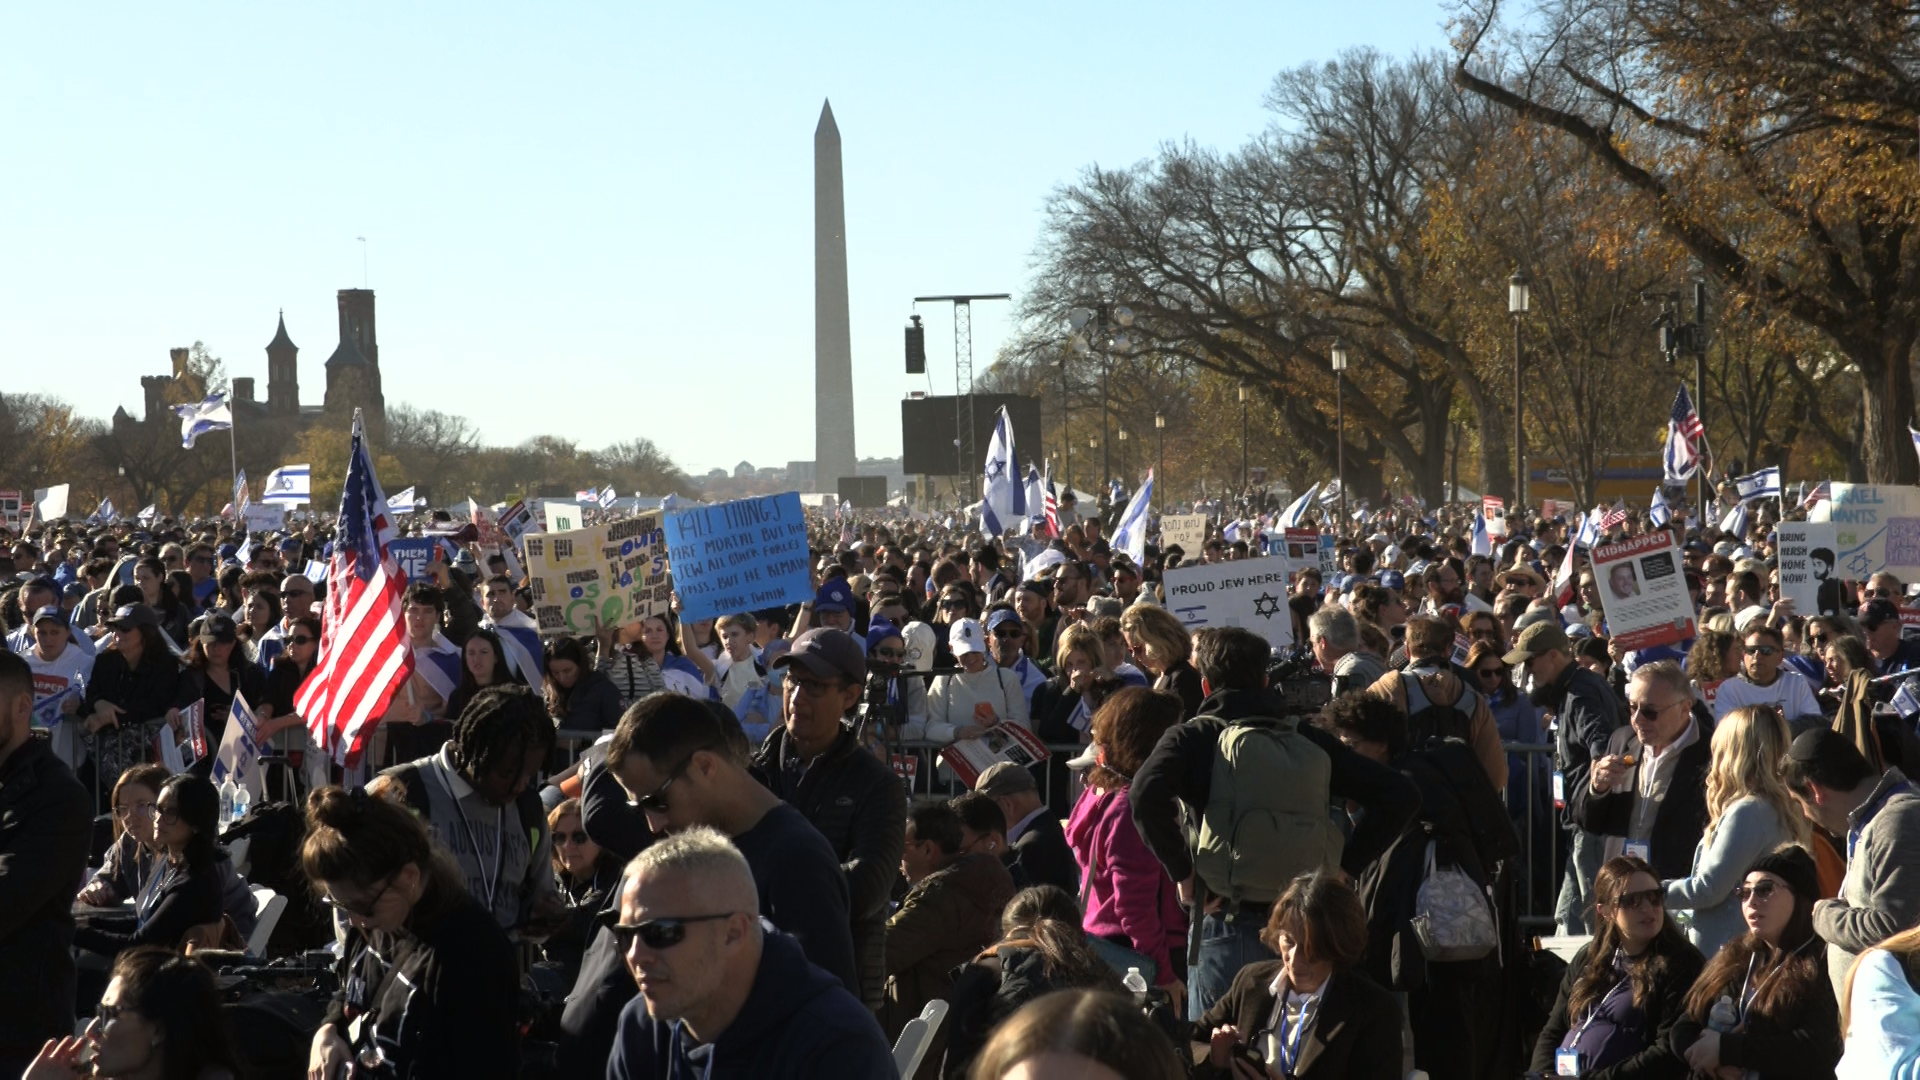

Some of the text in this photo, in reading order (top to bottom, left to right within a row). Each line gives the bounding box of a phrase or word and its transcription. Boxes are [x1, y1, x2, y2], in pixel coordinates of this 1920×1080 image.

[677, 509, 713, 540] ALL
[721, 495, 781, 530] THINGS
[621, 527, 664, 556] our
[670, 543, 697, 562] ARE
[704, 532, 755, 554] MORTAL
[761, 525, 785, 542] BUT
[1596, 533, 1667, 559] KIDNAPPED
[1780, 533, 1806, 542] BRING
[393, 547, 427, 560] THEM
[707, 557, 727, 573] ALL
[763, 538, 800, 557] FORCES
[1780, 546, 1807, 556] HERSH
[1781, 559, 1806, 570] HOME
[716, 573, 739, 590] BUT
[744, 568, 762, 583] HE
[1171, 572, 1282, 596] PROUD JEW HERE
[1781, 573, 1807, 584] NOW!
